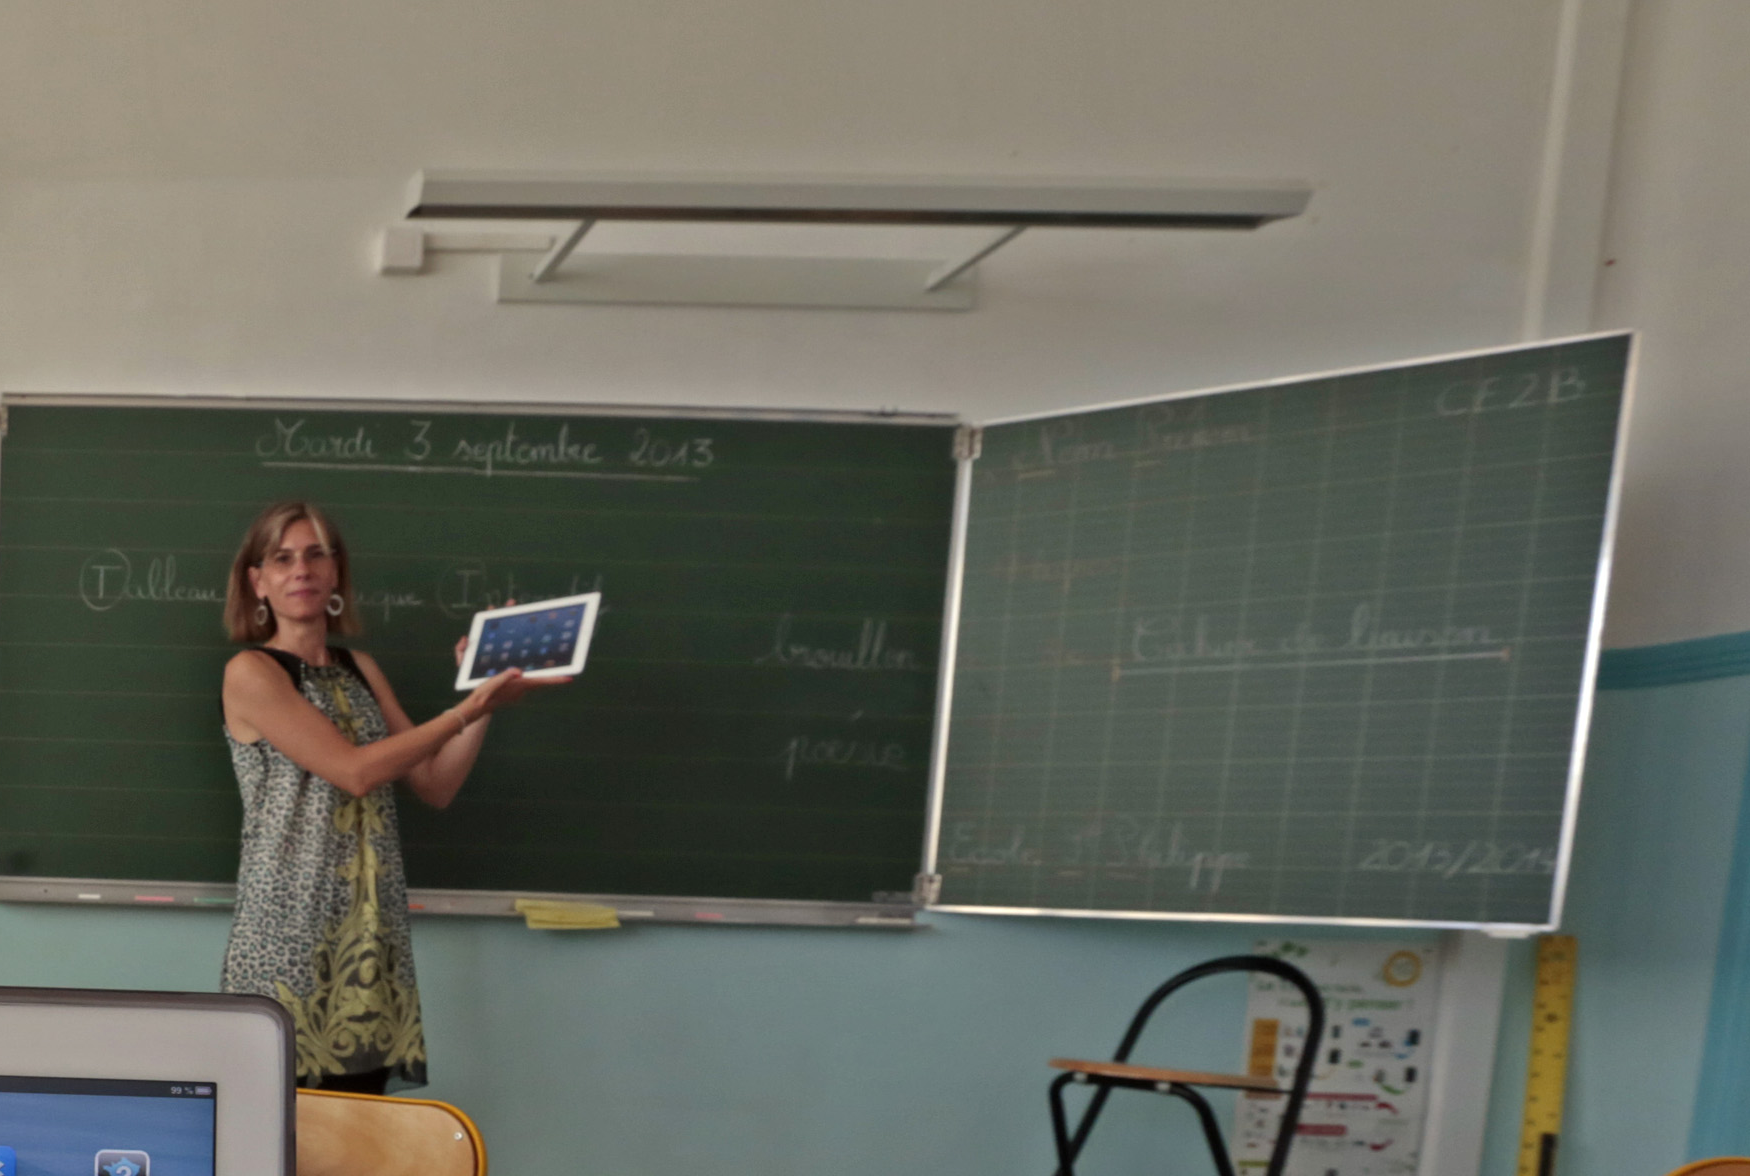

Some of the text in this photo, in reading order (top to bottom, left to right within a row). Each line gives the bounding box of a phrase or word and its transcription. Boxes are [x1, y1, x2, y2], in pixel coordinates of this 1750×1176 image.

[256, 417, 376, 460] Mardi
[403, 420, 432, 461] 3
[628, 429, 714, 468] 2013
